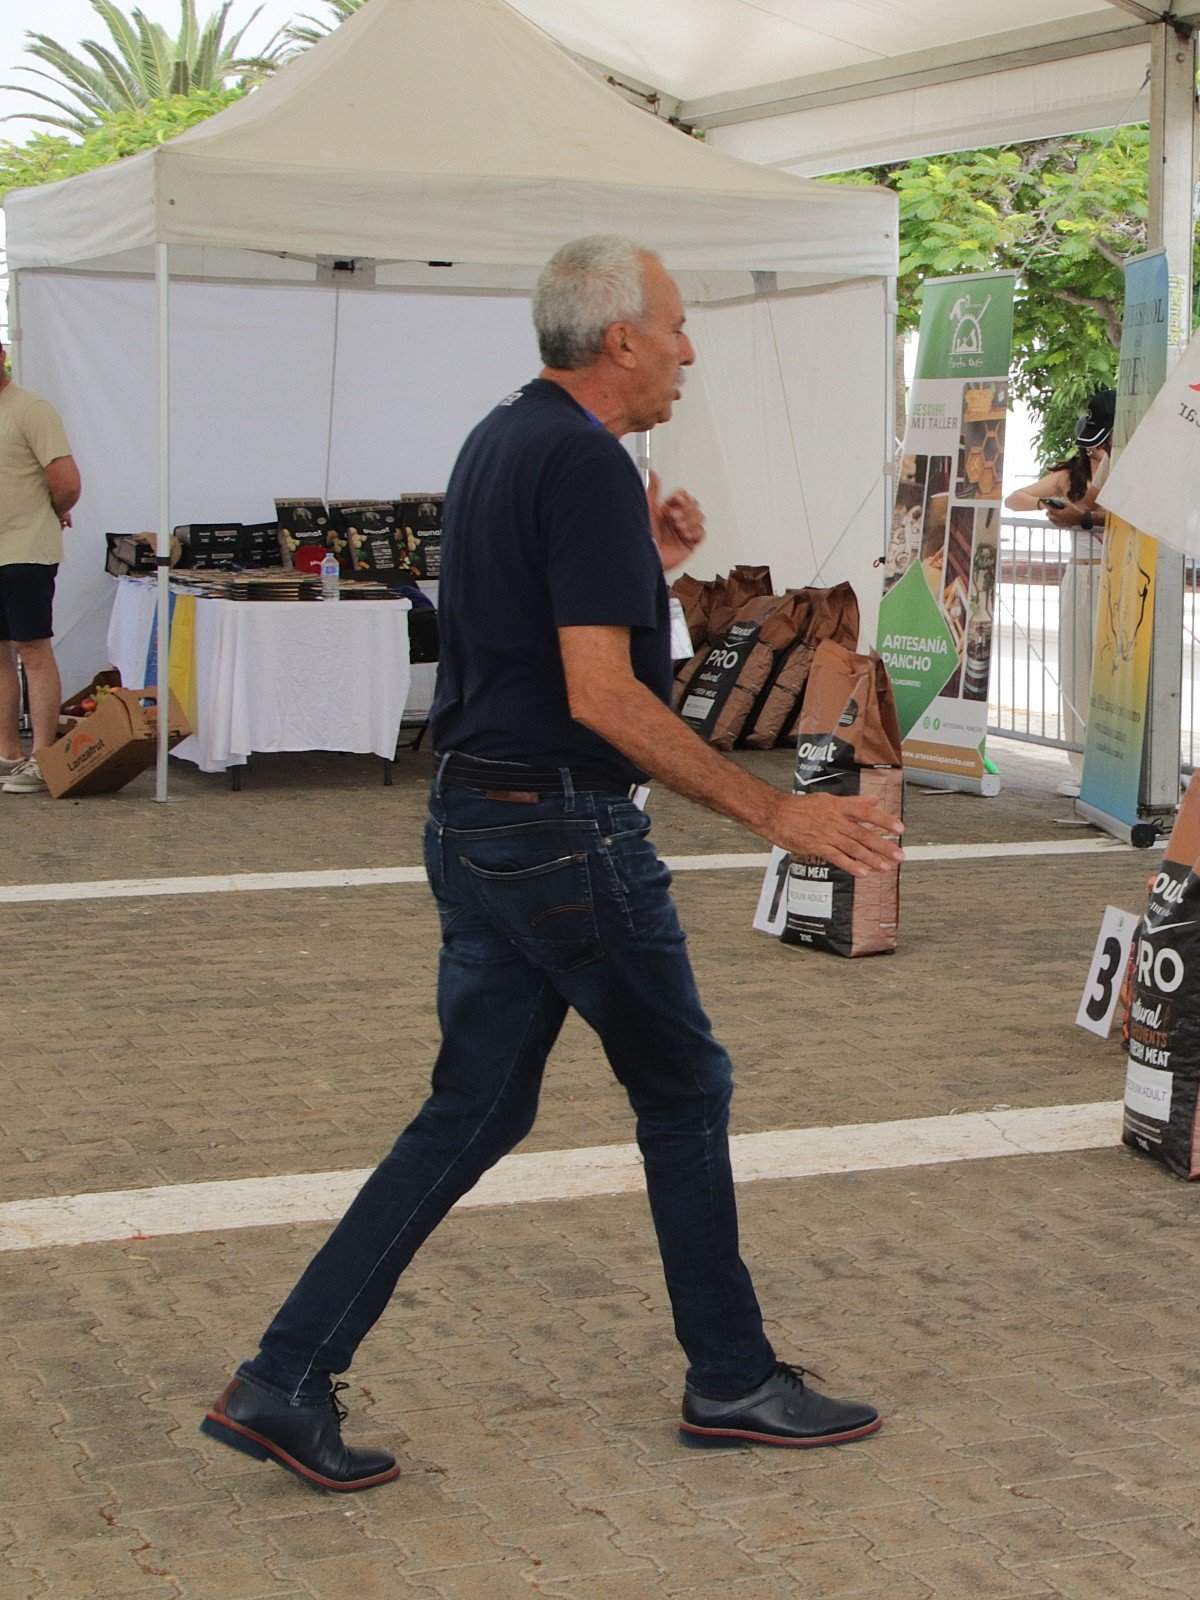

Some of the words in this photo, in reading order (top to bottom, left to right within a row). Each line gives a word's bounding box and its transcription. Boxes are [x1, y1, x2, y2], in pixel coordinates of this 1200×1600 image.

[882, 633, 948, 655] ARTESANÍA
[705, 648, 739, 669] PRO
[882, 652, 932, 672] PANCHO
[807, 866, 830, 880] MEAT
[767, 853, 792, 923] 1
[1086, 936, 1122, 1023] 3
[1144, 1048, 1171, 1068] MEAT
